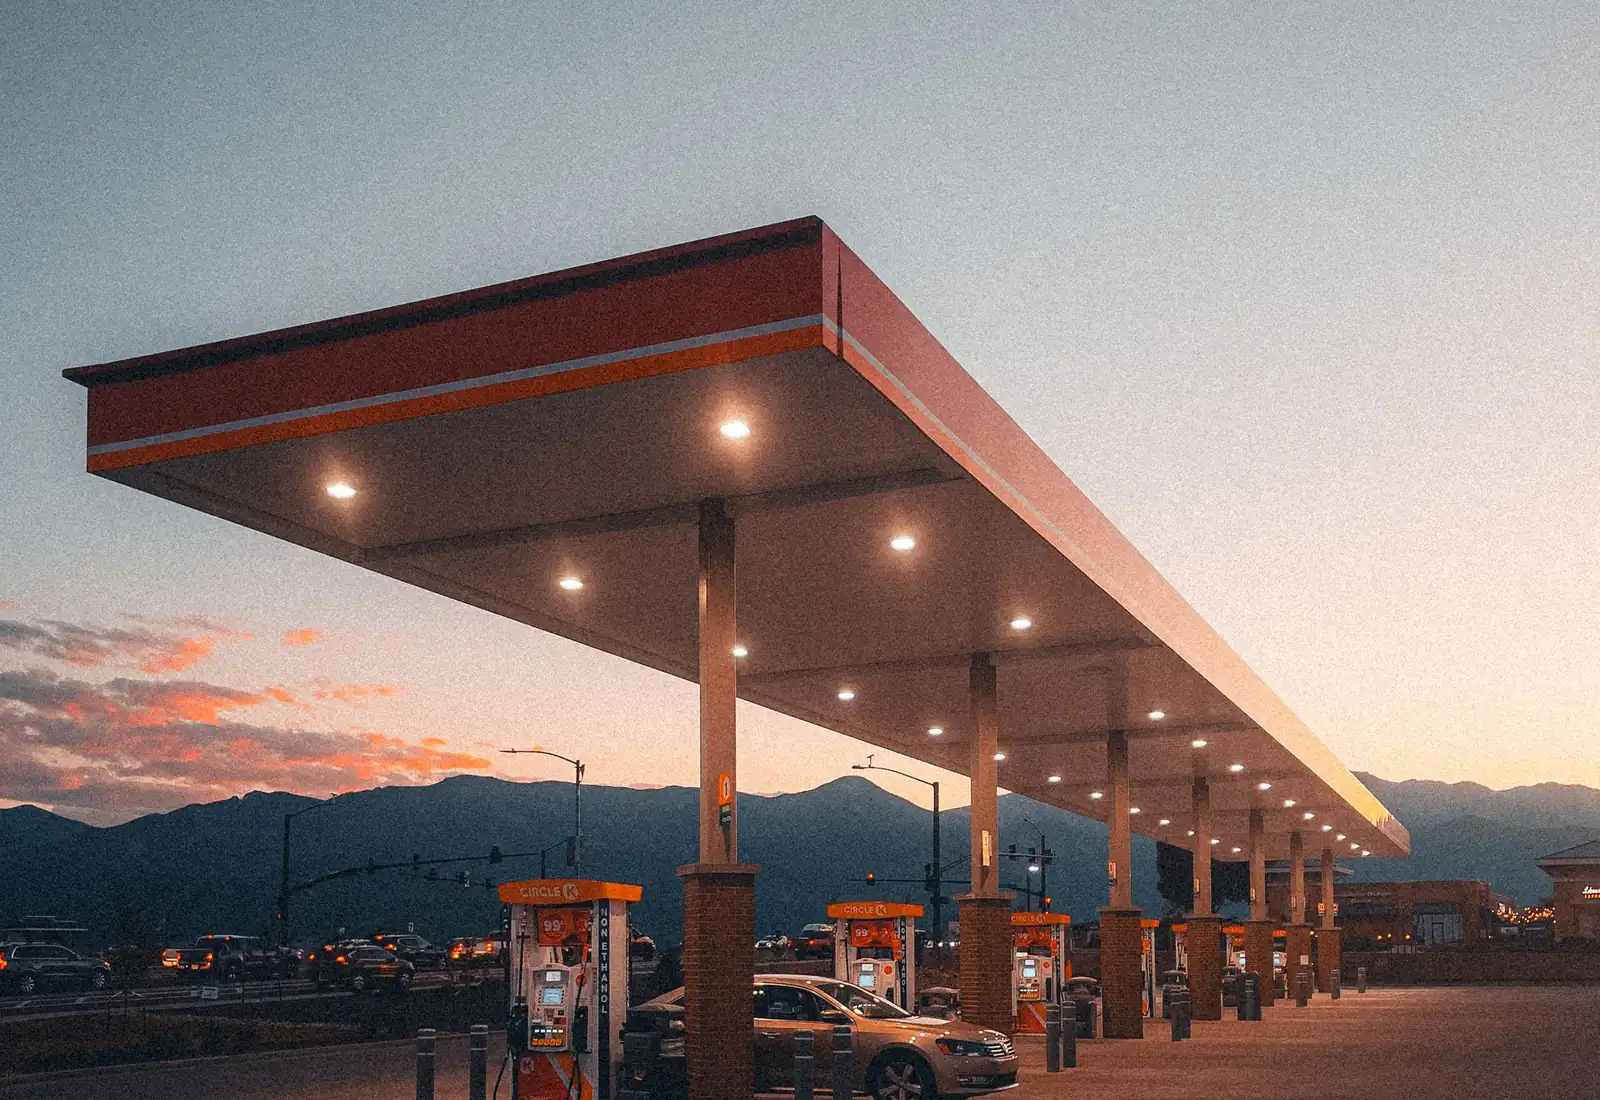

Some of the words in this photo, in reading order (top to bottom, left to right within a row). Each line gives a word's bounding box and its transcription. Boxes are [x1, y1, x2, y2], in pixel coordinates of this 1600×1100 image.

[520, 886, 561, 897] CIRCLE
[562, 883, 579, 900] K
[843, 906, 874, 914] CIRCLE
[875, 904, 887, 916] K
[519, 1056, 535, 1075] K
